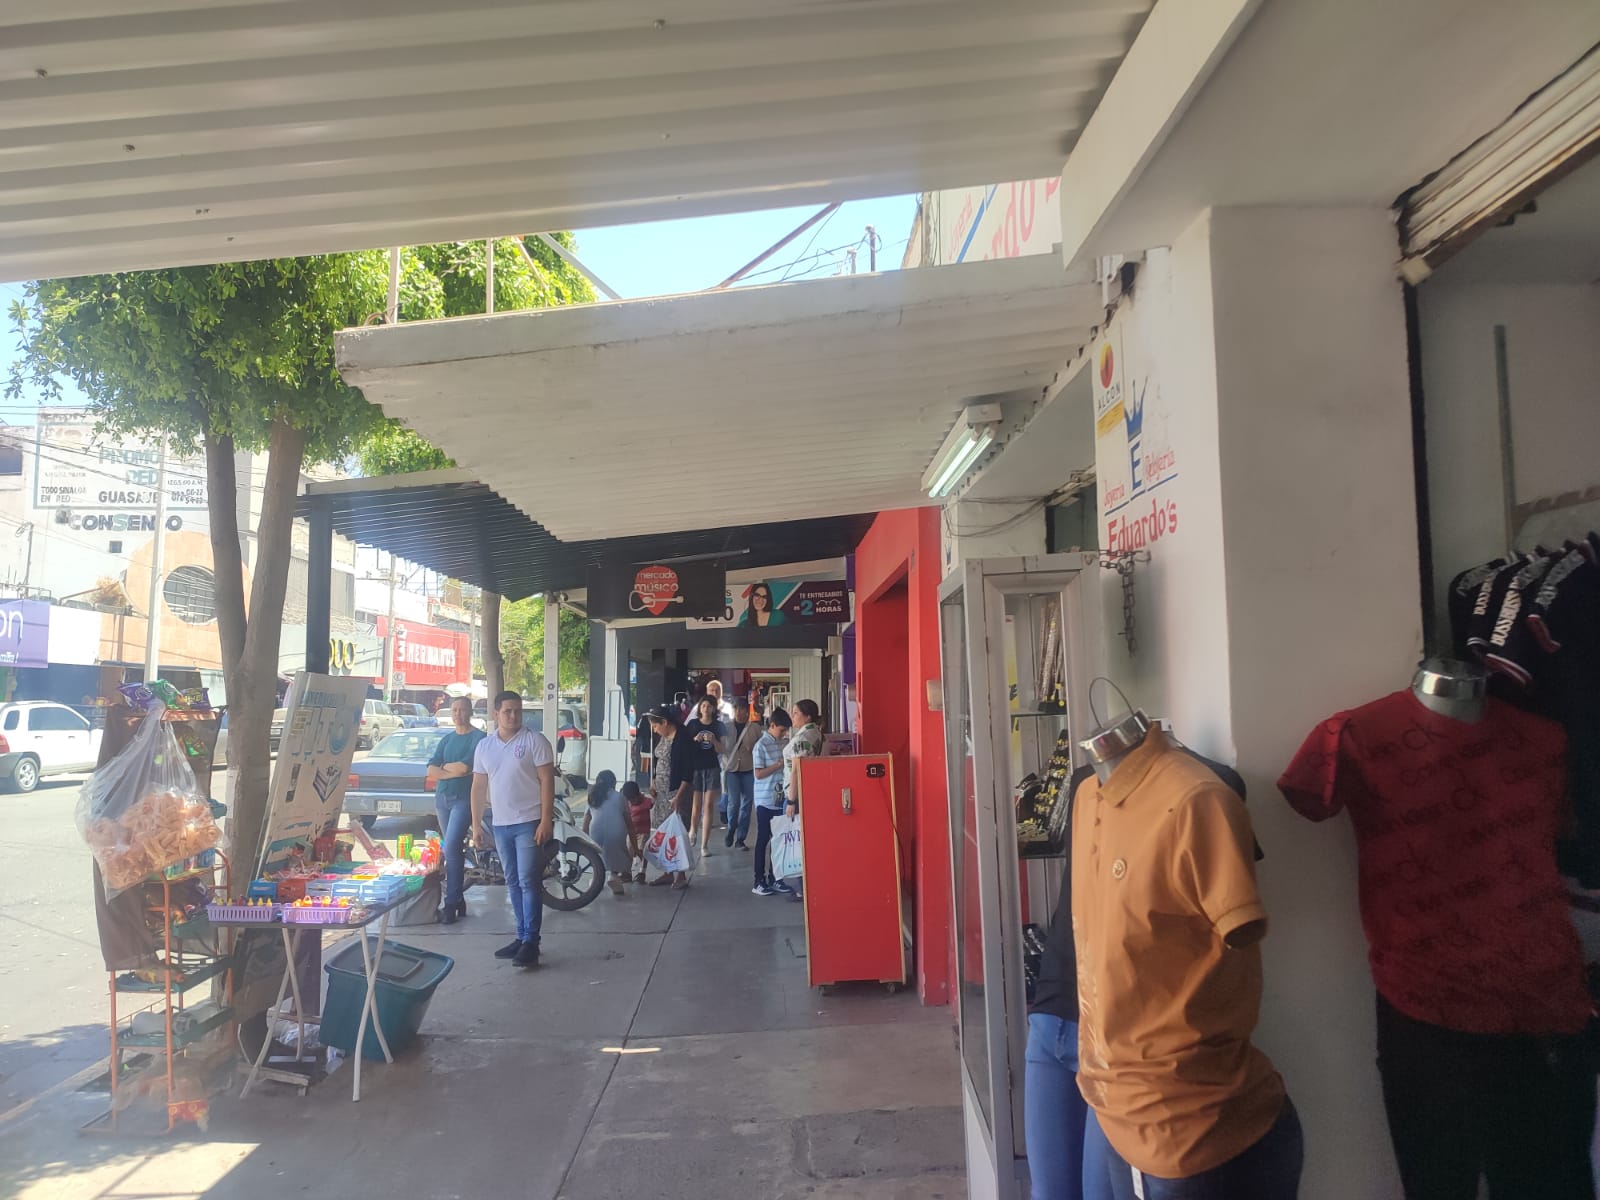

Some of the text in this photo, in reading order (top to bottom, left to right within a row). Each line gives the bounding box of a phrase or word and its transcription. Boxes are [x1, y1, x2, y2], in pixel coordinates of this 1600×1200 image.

[1098, 384, 1121, 411] ALCON
[1130, 442, 1143, 491] E
[1107, 497, 1179, 562] Eduardo's
[800, 599, 814, 616] 2
[815, 605, 842, 613] HORAS
